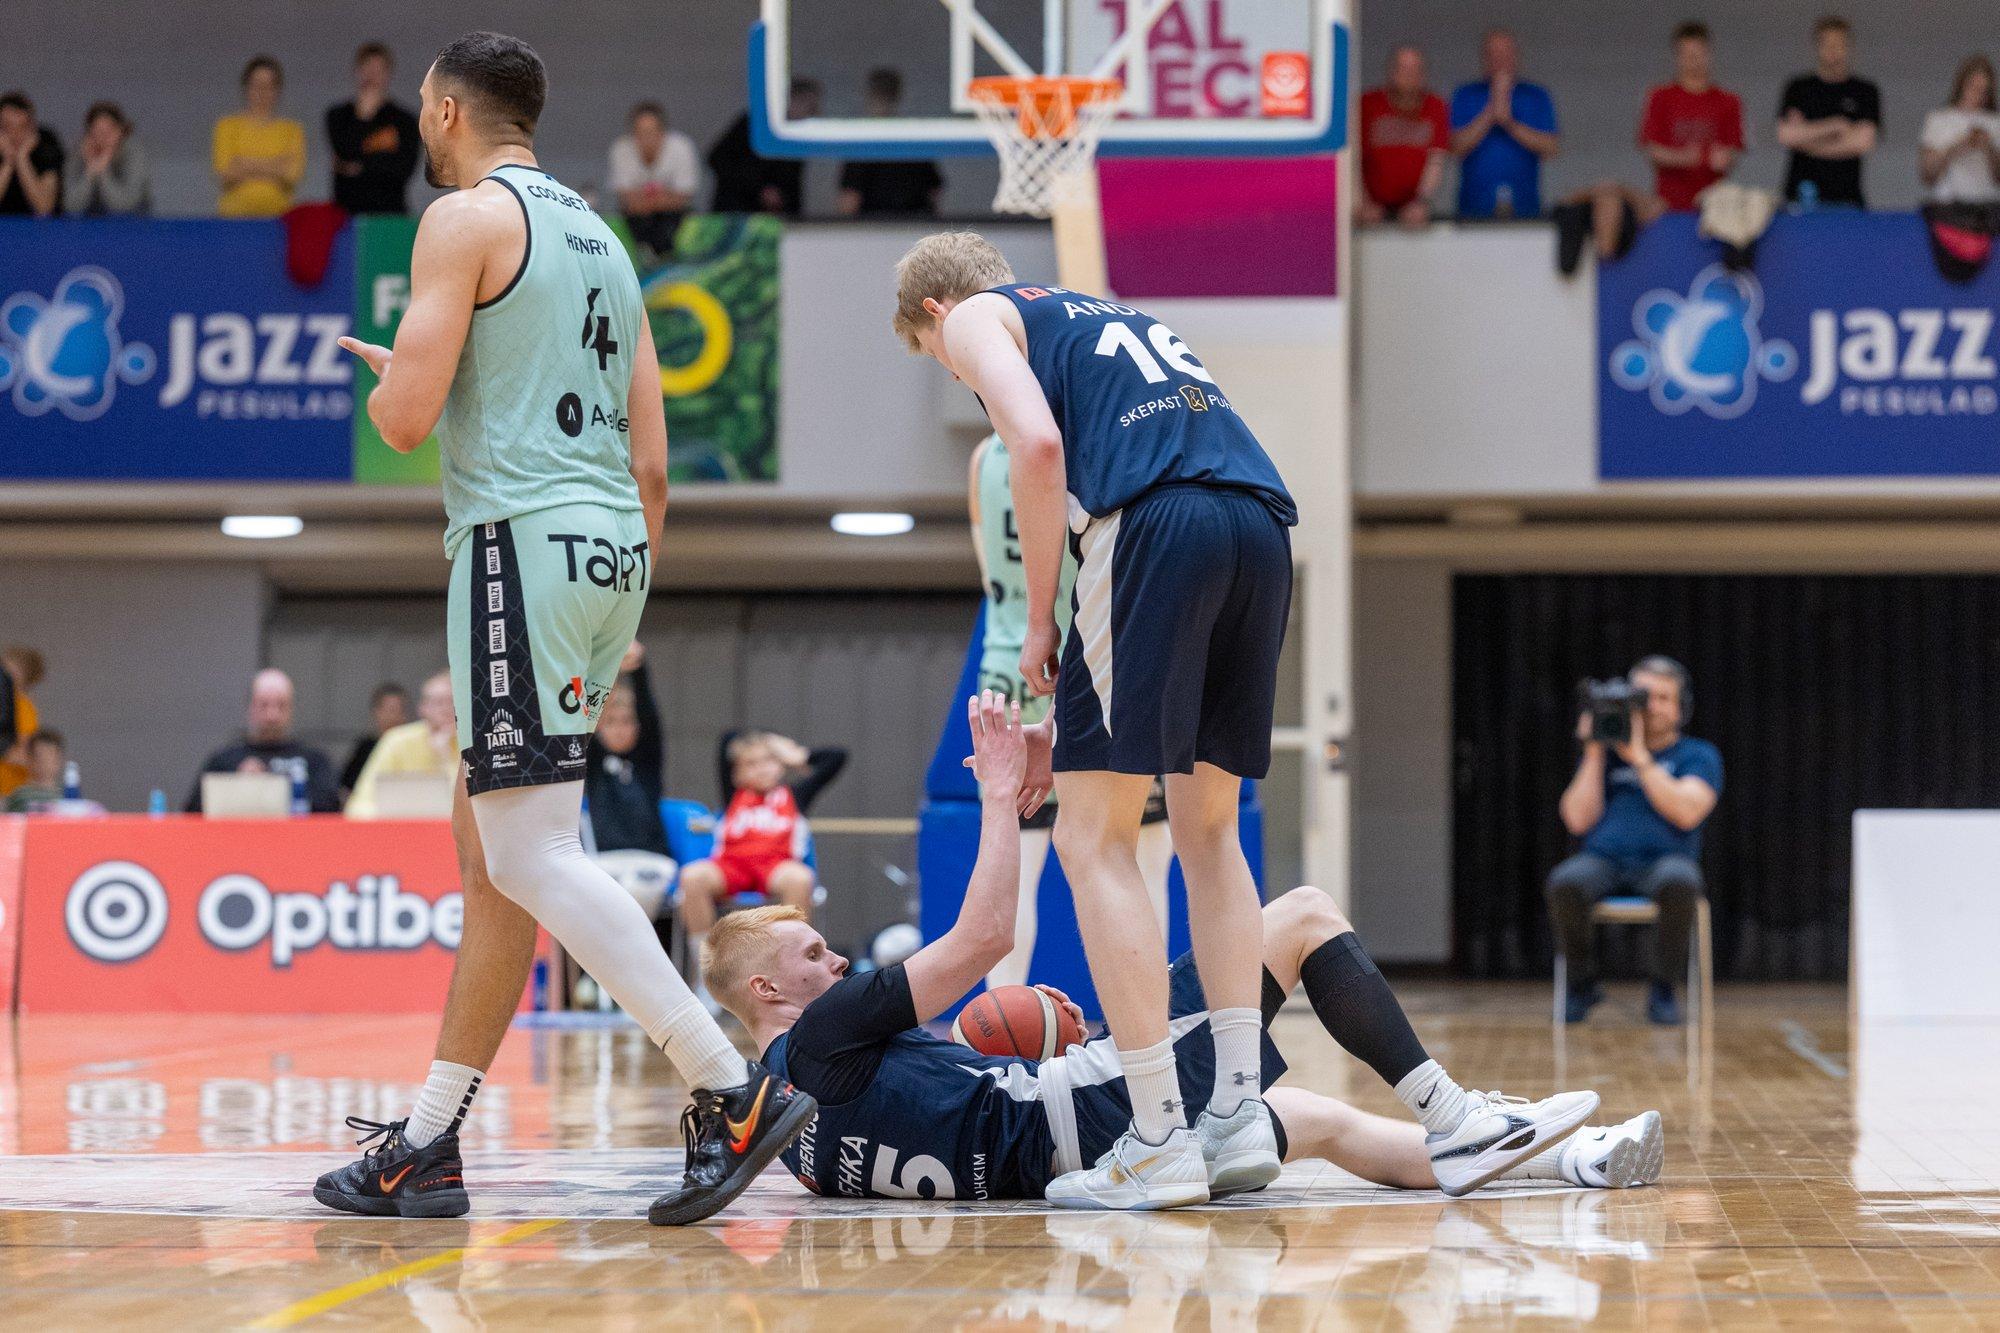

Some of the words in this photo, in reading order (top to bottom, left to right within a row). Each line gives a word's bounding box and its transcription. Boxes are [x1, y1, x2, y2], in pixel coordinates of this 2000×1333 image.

[527, 185, 598, 217] COOLBET
[565, 232, 609, 256] HENRY
[1063, 301, 1151, 319] AND
[582, 288, 618, 371] 4
[1094, 321, 1216, 384] 16
[1119, 396, 1183, 427] SKEPAST
[489, 550, 498, 572] BALLZY
[491, 585, 500, 609] BALLZY
[492, 624, 503, 650] BALLZY
[493, 665, 505, 693] BALLZY
[484, 729, 524, 750] TARTU
[199, 875, 463, 969] Optibe
[871, 1143, 956, 1199] 5
